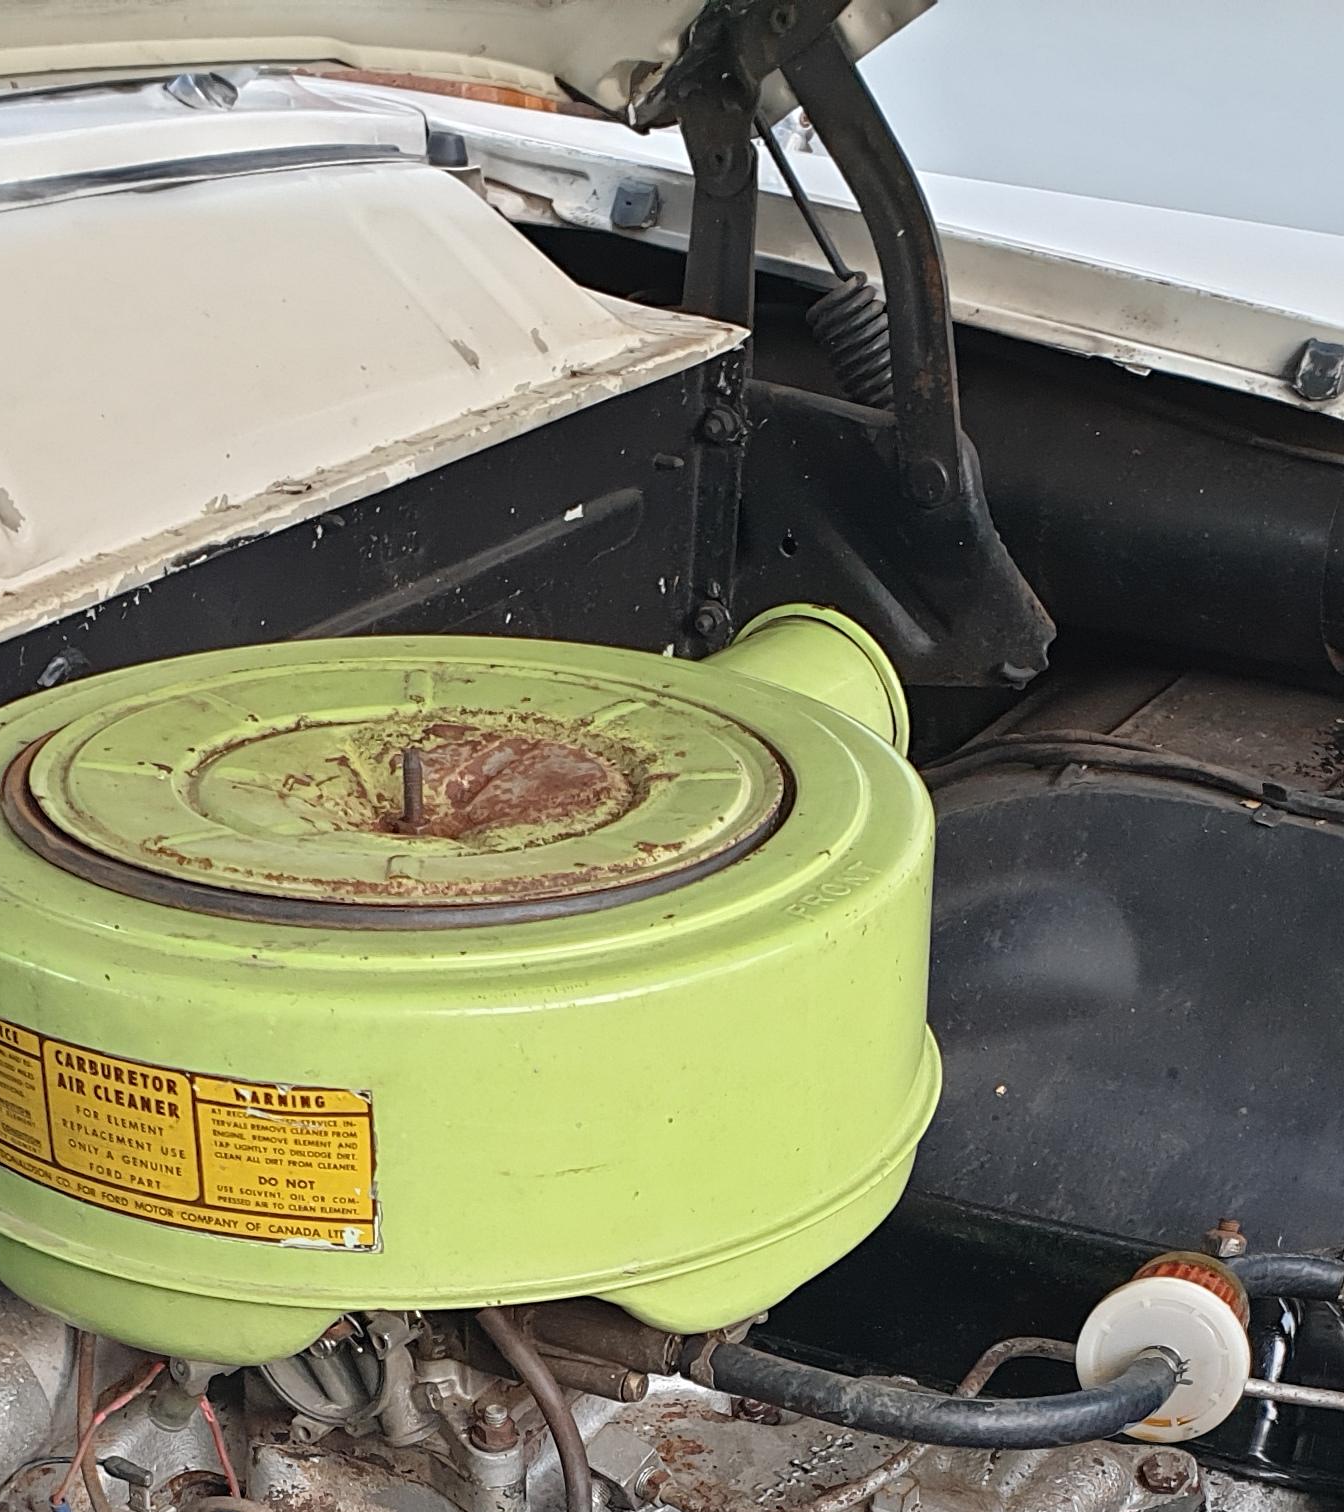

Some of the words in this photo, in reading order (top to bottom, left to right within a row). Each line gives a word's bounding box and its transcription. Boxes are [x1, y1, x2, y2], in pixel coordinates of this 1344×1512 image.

[55, 1050, 178, 1095] CARBURETOR
[58, 1073, 86, 1096] AIR
[94, 1085, 180, 1119] CLEANER
[76, 1105, 99, 1120] FOR
[107, 1114, 163, 1136] ELEMENT
[212, 1119, 247, 1129] TERVALS
[251, 1124, 286, 1134] REMOVE
[290, 1128, 328, 1137] CLEANER
[62, 1118, 152, 1152] REPLACEMENT
[161, 1146, 186, 1159] USE
[235, 1144, 267, 1153] LIGHTLY
[253, 1135, 288, 1145] REMOVE
[294, 1139, 331, 1148] ELEMENT
[69, 1139, 98, 1155] ONLY
[107, 1151, 114, 1160] A
[122, 1155, 182, 1176] GENUINE
[215, 1152, 241, 1161] CLEAN
[288, 1160, 312, 1168] FROM
[89, 1163, 122, 1180] FORD
[130, 1174, 161, 1189] PART
[258, 1177, 278, 1185] DO
[287, 1180, 315, 1190] NOT
[0, 1148, 52, 1179] DONALDSON
[78, 1184, 95, 1196] FOR
[102, 1192, 128, 1206] FORD
[135, 1201, 173, 1218] MOTOR
[181, 1212, 238, 1230] COMPANY
[246, 1222, 261, 1232] OF
[269, 1225, 320, 1238] CANADA
[217, 1185, 233, 1193] USE
[218, 1196, 251, 1206] PRESSED
